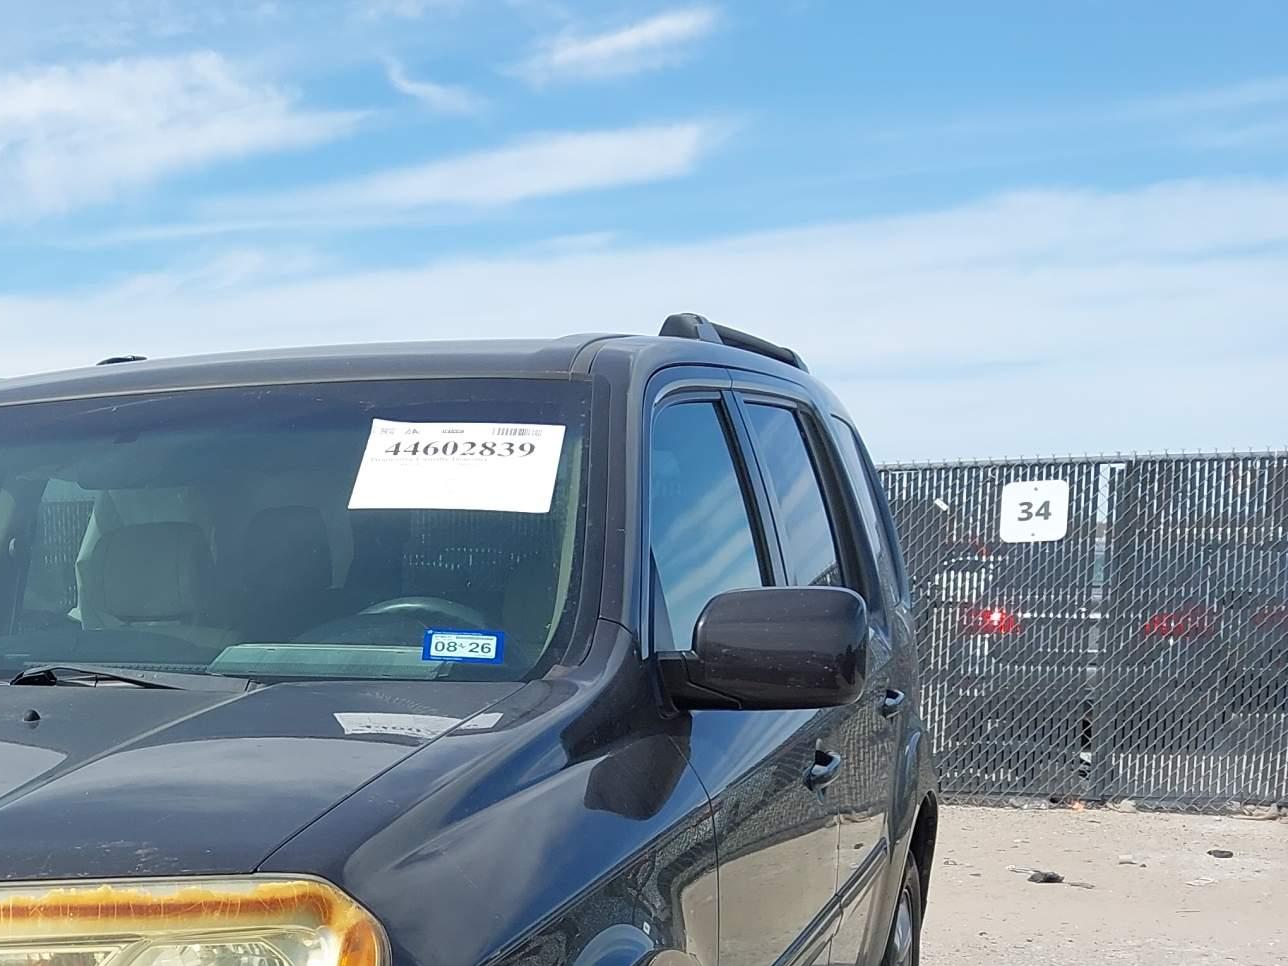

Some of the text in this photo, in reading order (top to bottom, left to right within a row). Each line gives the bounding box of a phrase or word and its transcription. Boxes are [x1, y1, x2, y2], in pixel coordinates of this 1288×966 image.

[384, 440, 536, 458] 44602839
[1017, 500, 1052, 522] 34
[434, 640, 492, 654] 08 26
